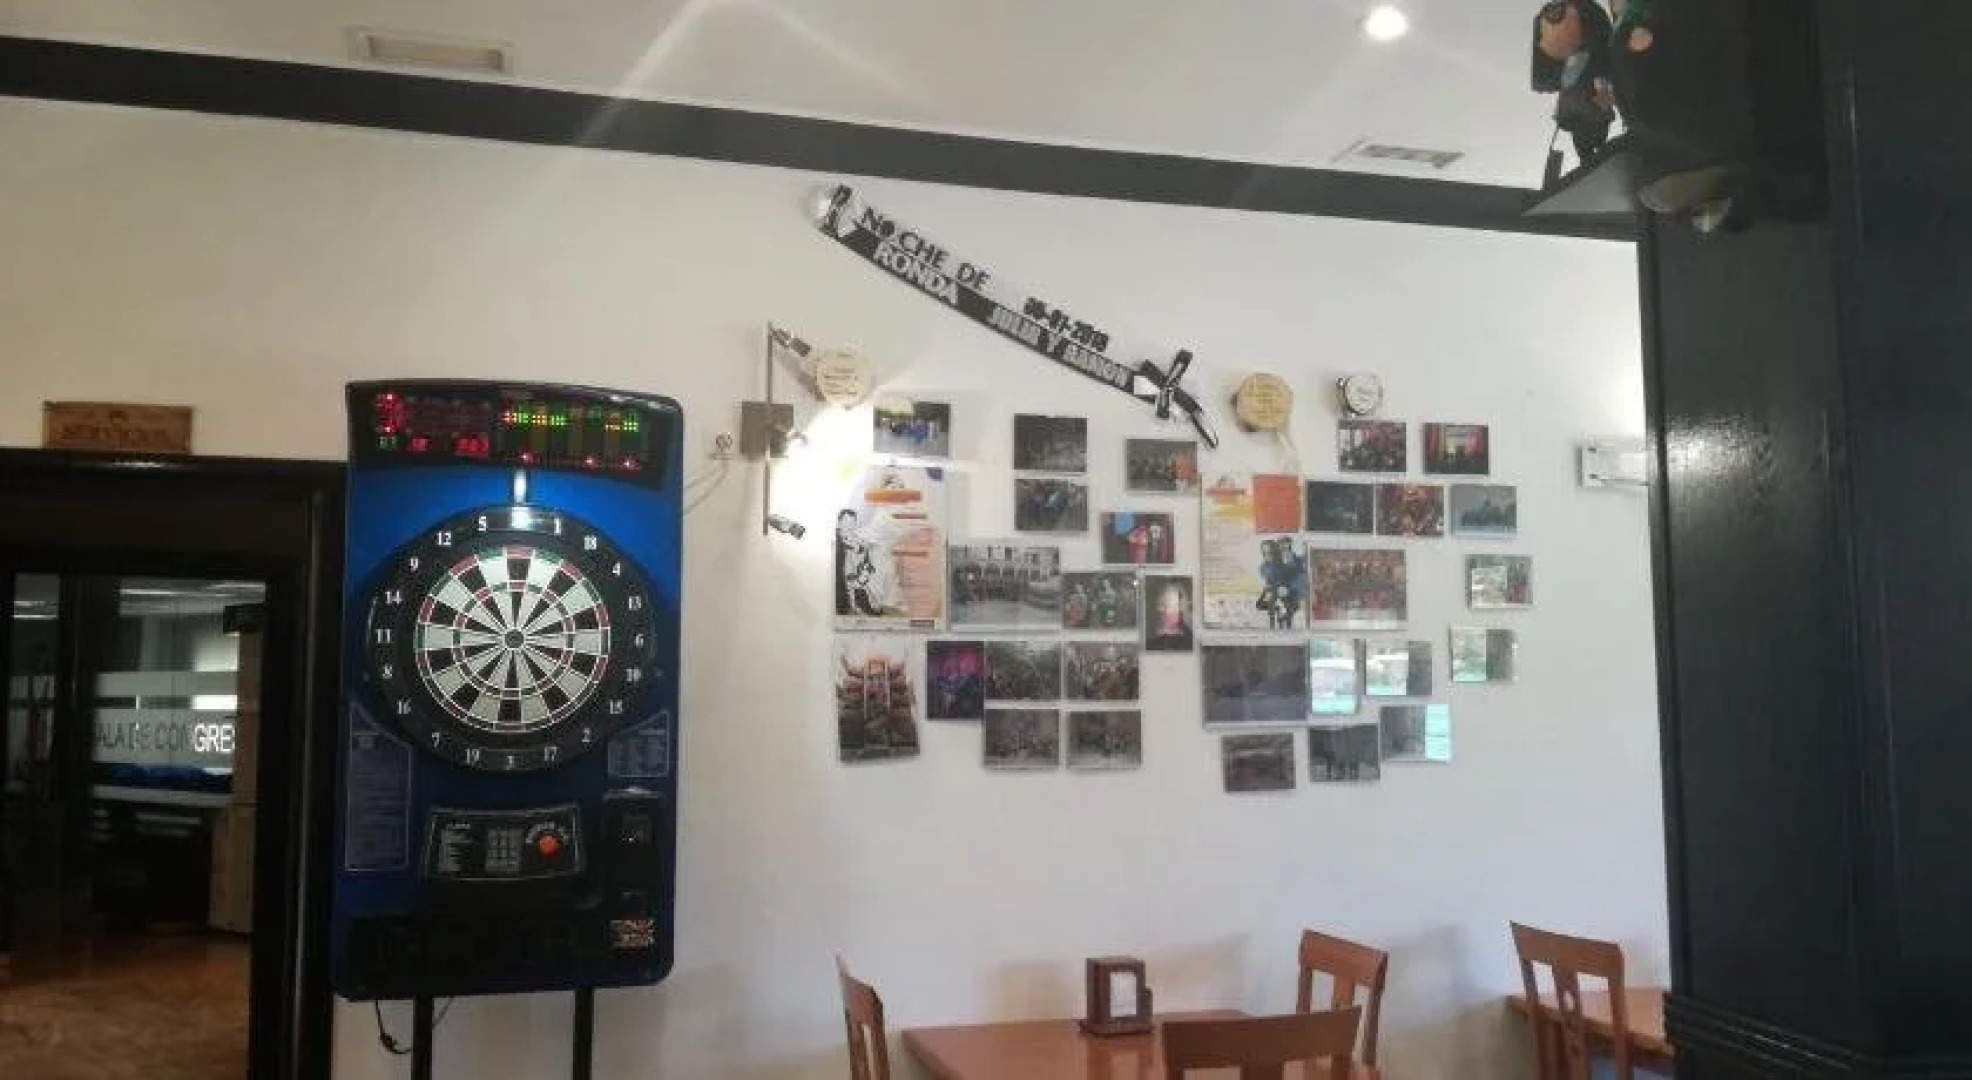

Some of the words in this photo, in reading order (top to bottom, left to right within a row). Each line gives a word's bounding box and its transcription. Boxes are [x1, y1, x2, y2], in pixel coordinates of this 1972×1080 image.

[861, 206, 950, 269] NOCHE
[957, 262, 990, 290] DE
[873, 240, 957, 304] RONDA
[478, 515, 488, 531] 5
[553, 518, 562, 535] 1
[436, 531, 452, 546] 12
[410, 556, 419, 571] 9
[612, 561, 621, 576] 4
[385, 590, 401, 605] 14
[377, 628, 391, 644] 11
[581, 727, 591, 743] 2
[465, 748, 481, 764] 19
[543, 745, 557, 762] 17
